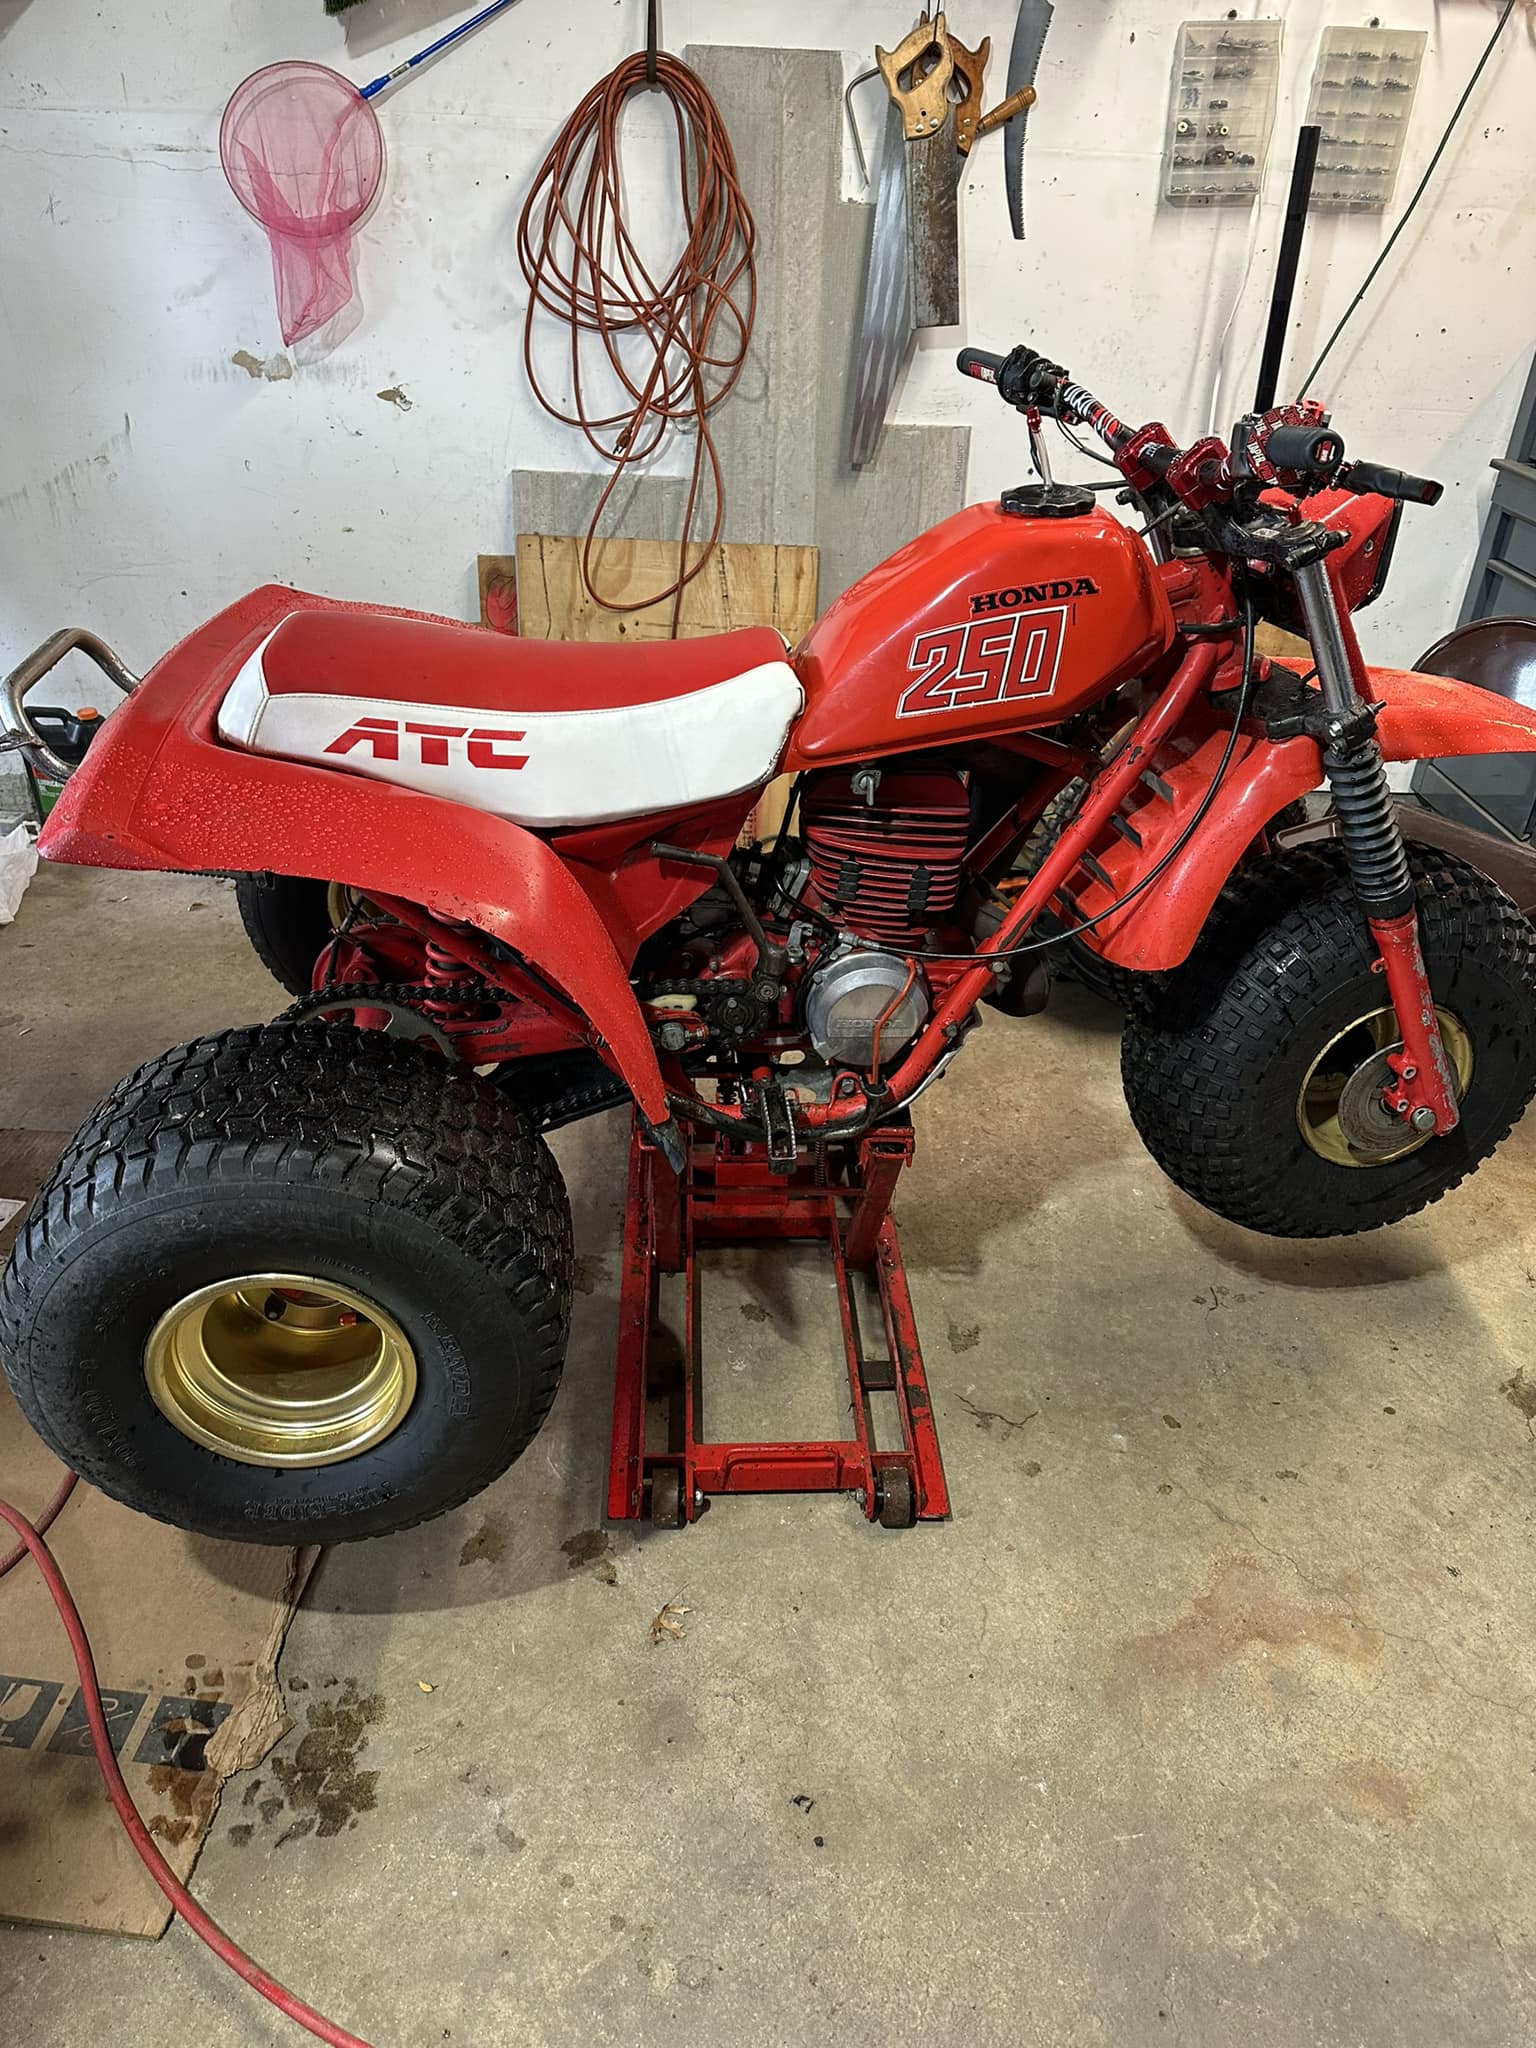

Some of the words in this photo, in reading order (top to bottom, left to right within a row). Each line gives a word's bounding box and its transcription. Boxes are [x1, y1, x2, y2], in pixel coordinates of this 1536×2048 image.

[971, 577, 1100, 613] HONDA
[896, 605, 1069, 719] 250
[323, 717, 530, 770] ATC
